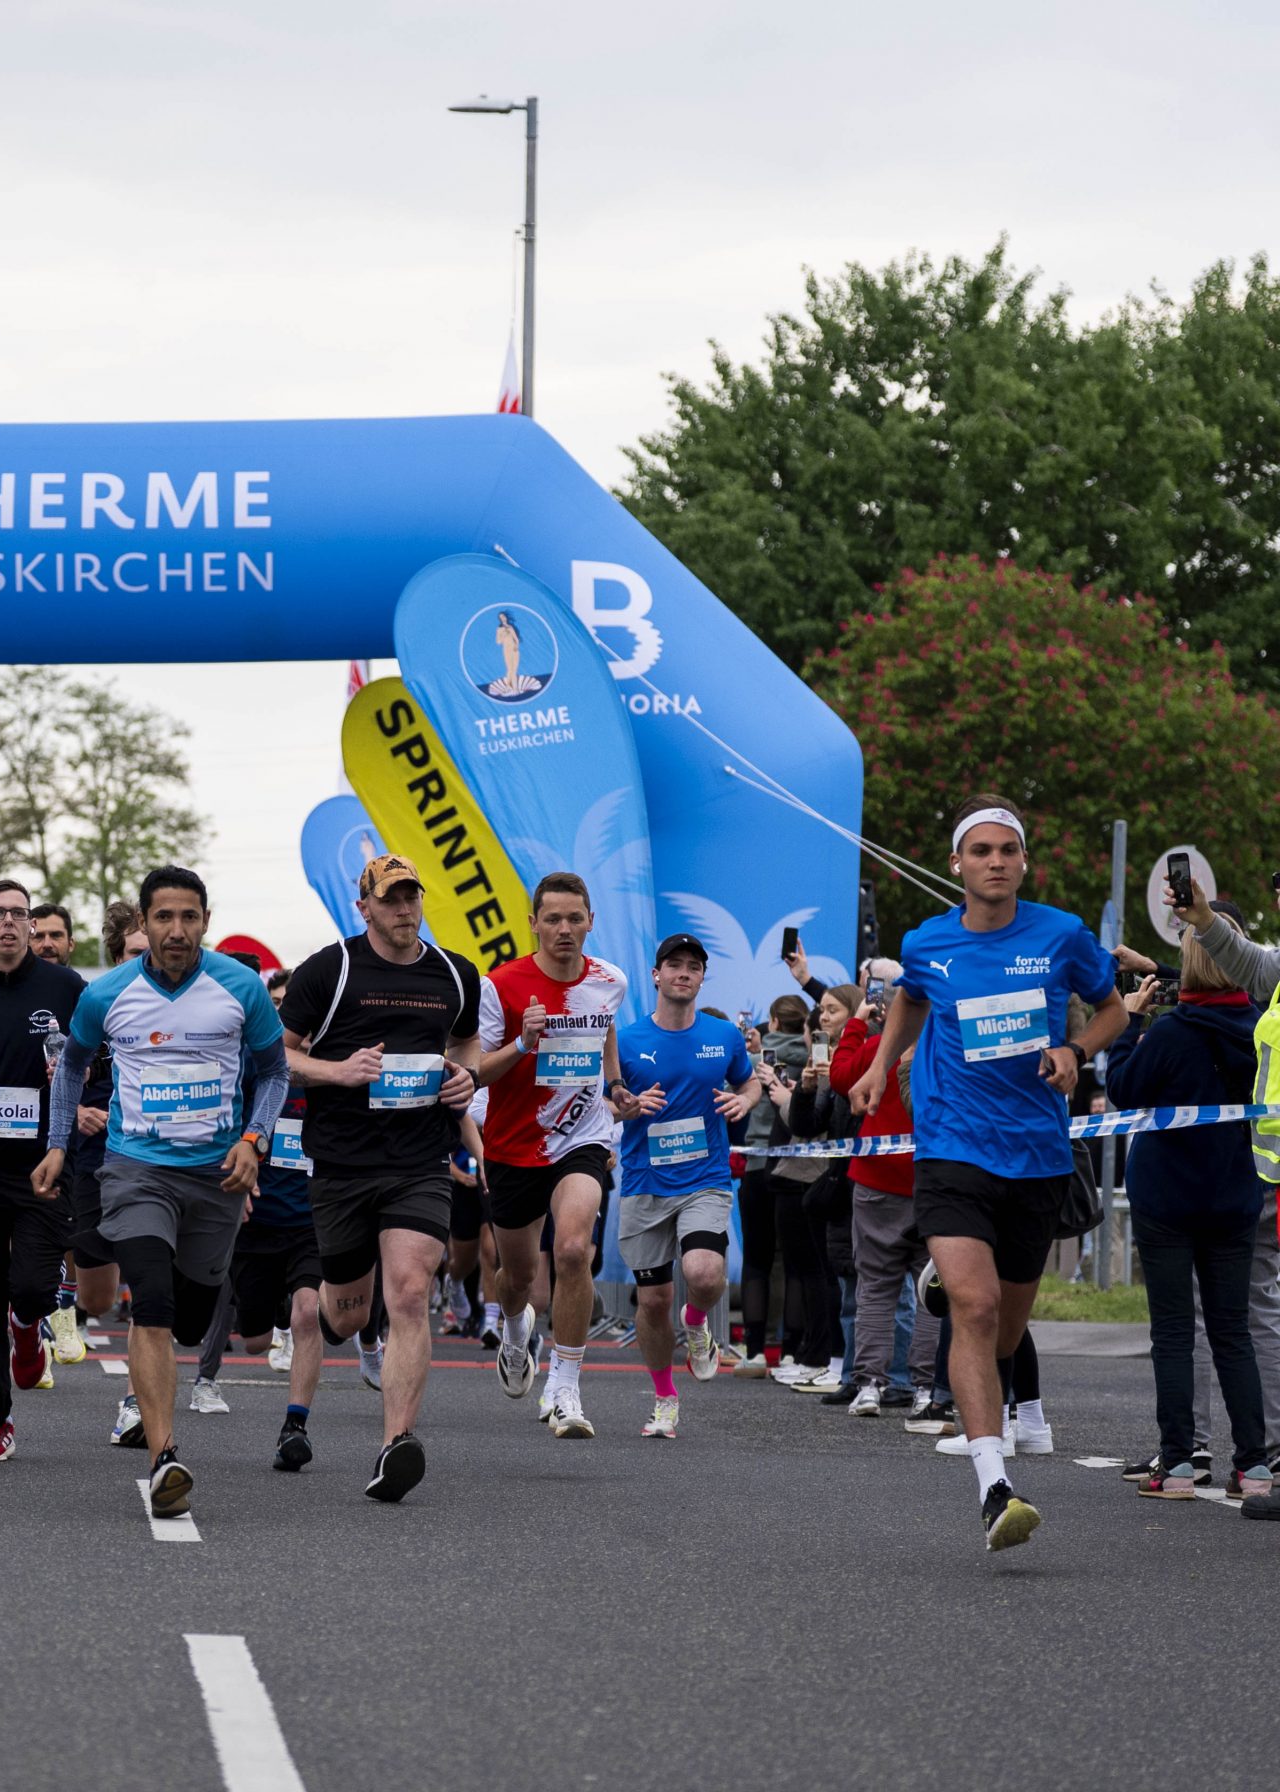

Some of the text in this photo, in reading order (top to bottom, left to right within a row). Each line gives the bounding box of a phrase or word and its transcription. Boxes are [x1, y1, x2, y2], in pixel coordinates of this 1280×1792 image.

[621, 693, 702, 715] ORIA
[475, 706, 571, 737] THERME
[479, 728, 575, 755] EUSKIRCHEN
[375, 698, 518, 972] SPRINTER
[1004, 965, 1051, 976] mazars
[390, 1000, 447, 1010] ACHTERBAHNEN
[976, 1013, 1031, 1036] Michel
[548, 1054, 592, 1067] Patrick
[384, 1073, 429, 1088] Pascal
[142, 1083, 220, 1101] Abdel-Illah
[176, 1104, 190, 1112] 444
[659, 1134, 695, 1149] Cedric
